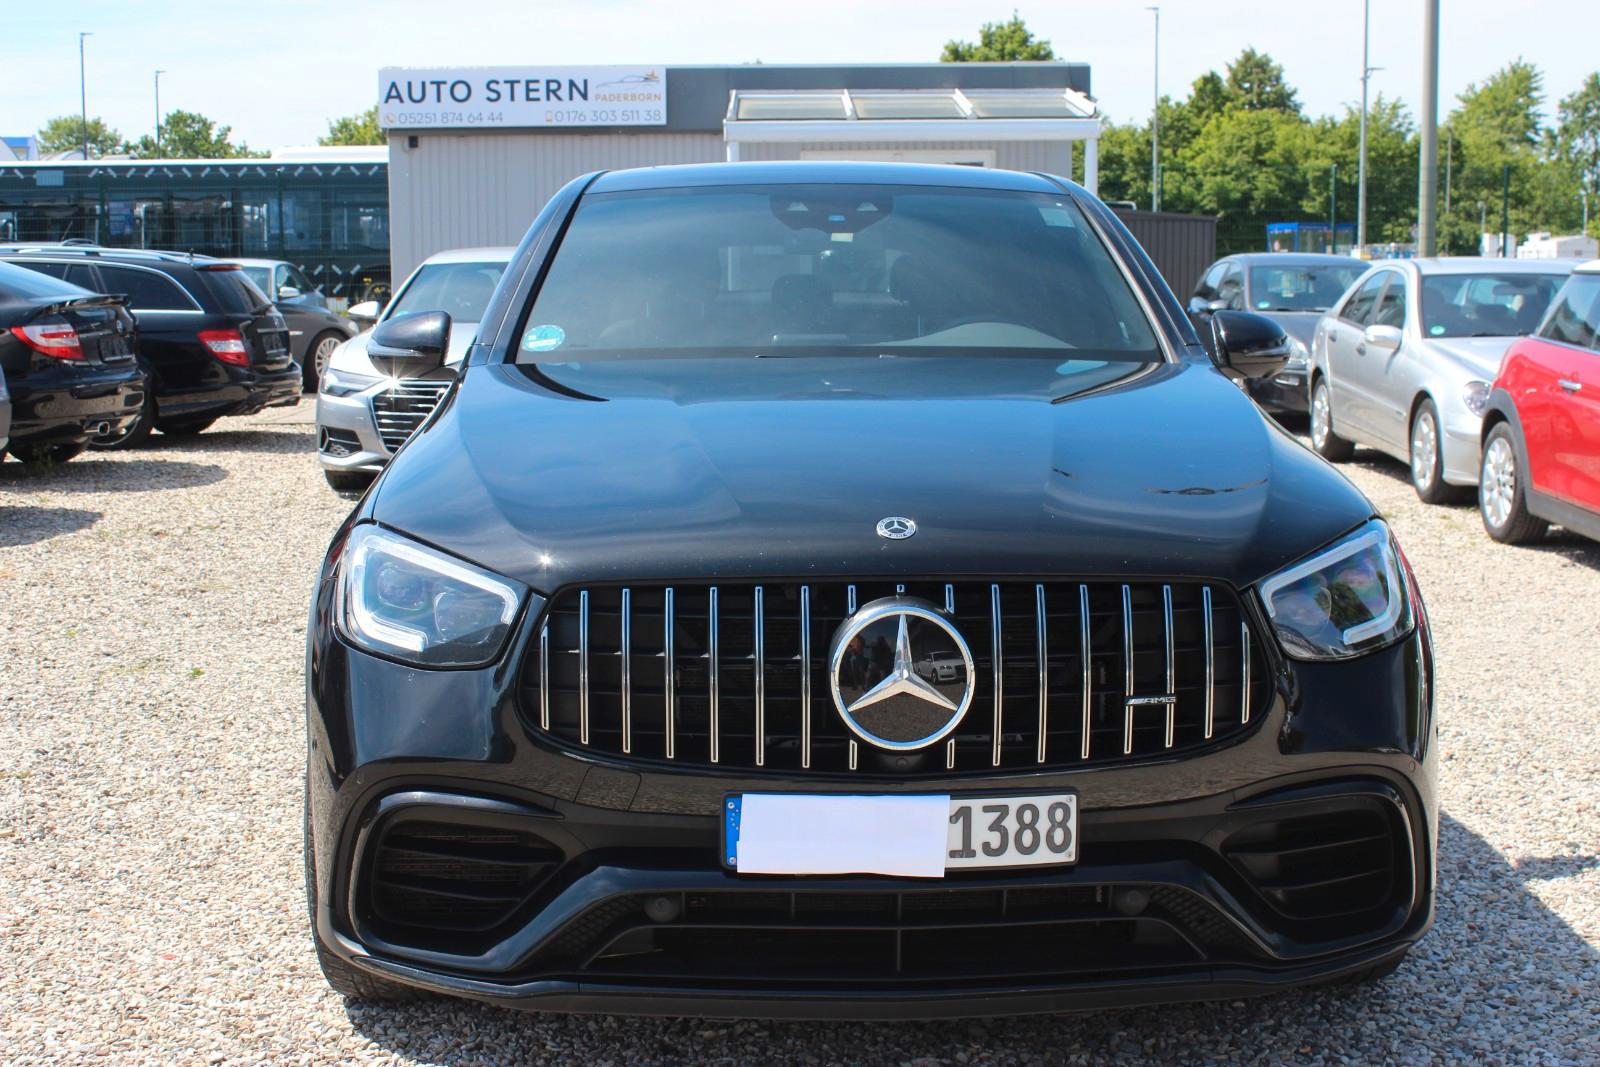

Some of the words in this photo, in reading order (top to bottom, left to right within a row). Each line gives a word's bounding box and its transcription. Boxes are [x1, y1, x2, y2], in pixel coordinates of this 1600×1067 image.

[384, 79, 472, 104] AUTO
[485, 78, 589, 103] STERN
[594, 93, 662, 102] PADERBORN
[398, 112, 437, 125] 05251
[440, 112, 463, 124] 874
[467, 111, 483, 124] 64
[487, 111, 503, 123] 44
[554, 110, 587, 122] 0176
[591, 110, 617, 122] 303
[621, 110, 640, 122] 511
[644, 109, 662, 121] 38
[948, 801, 1073, 859] 1388
